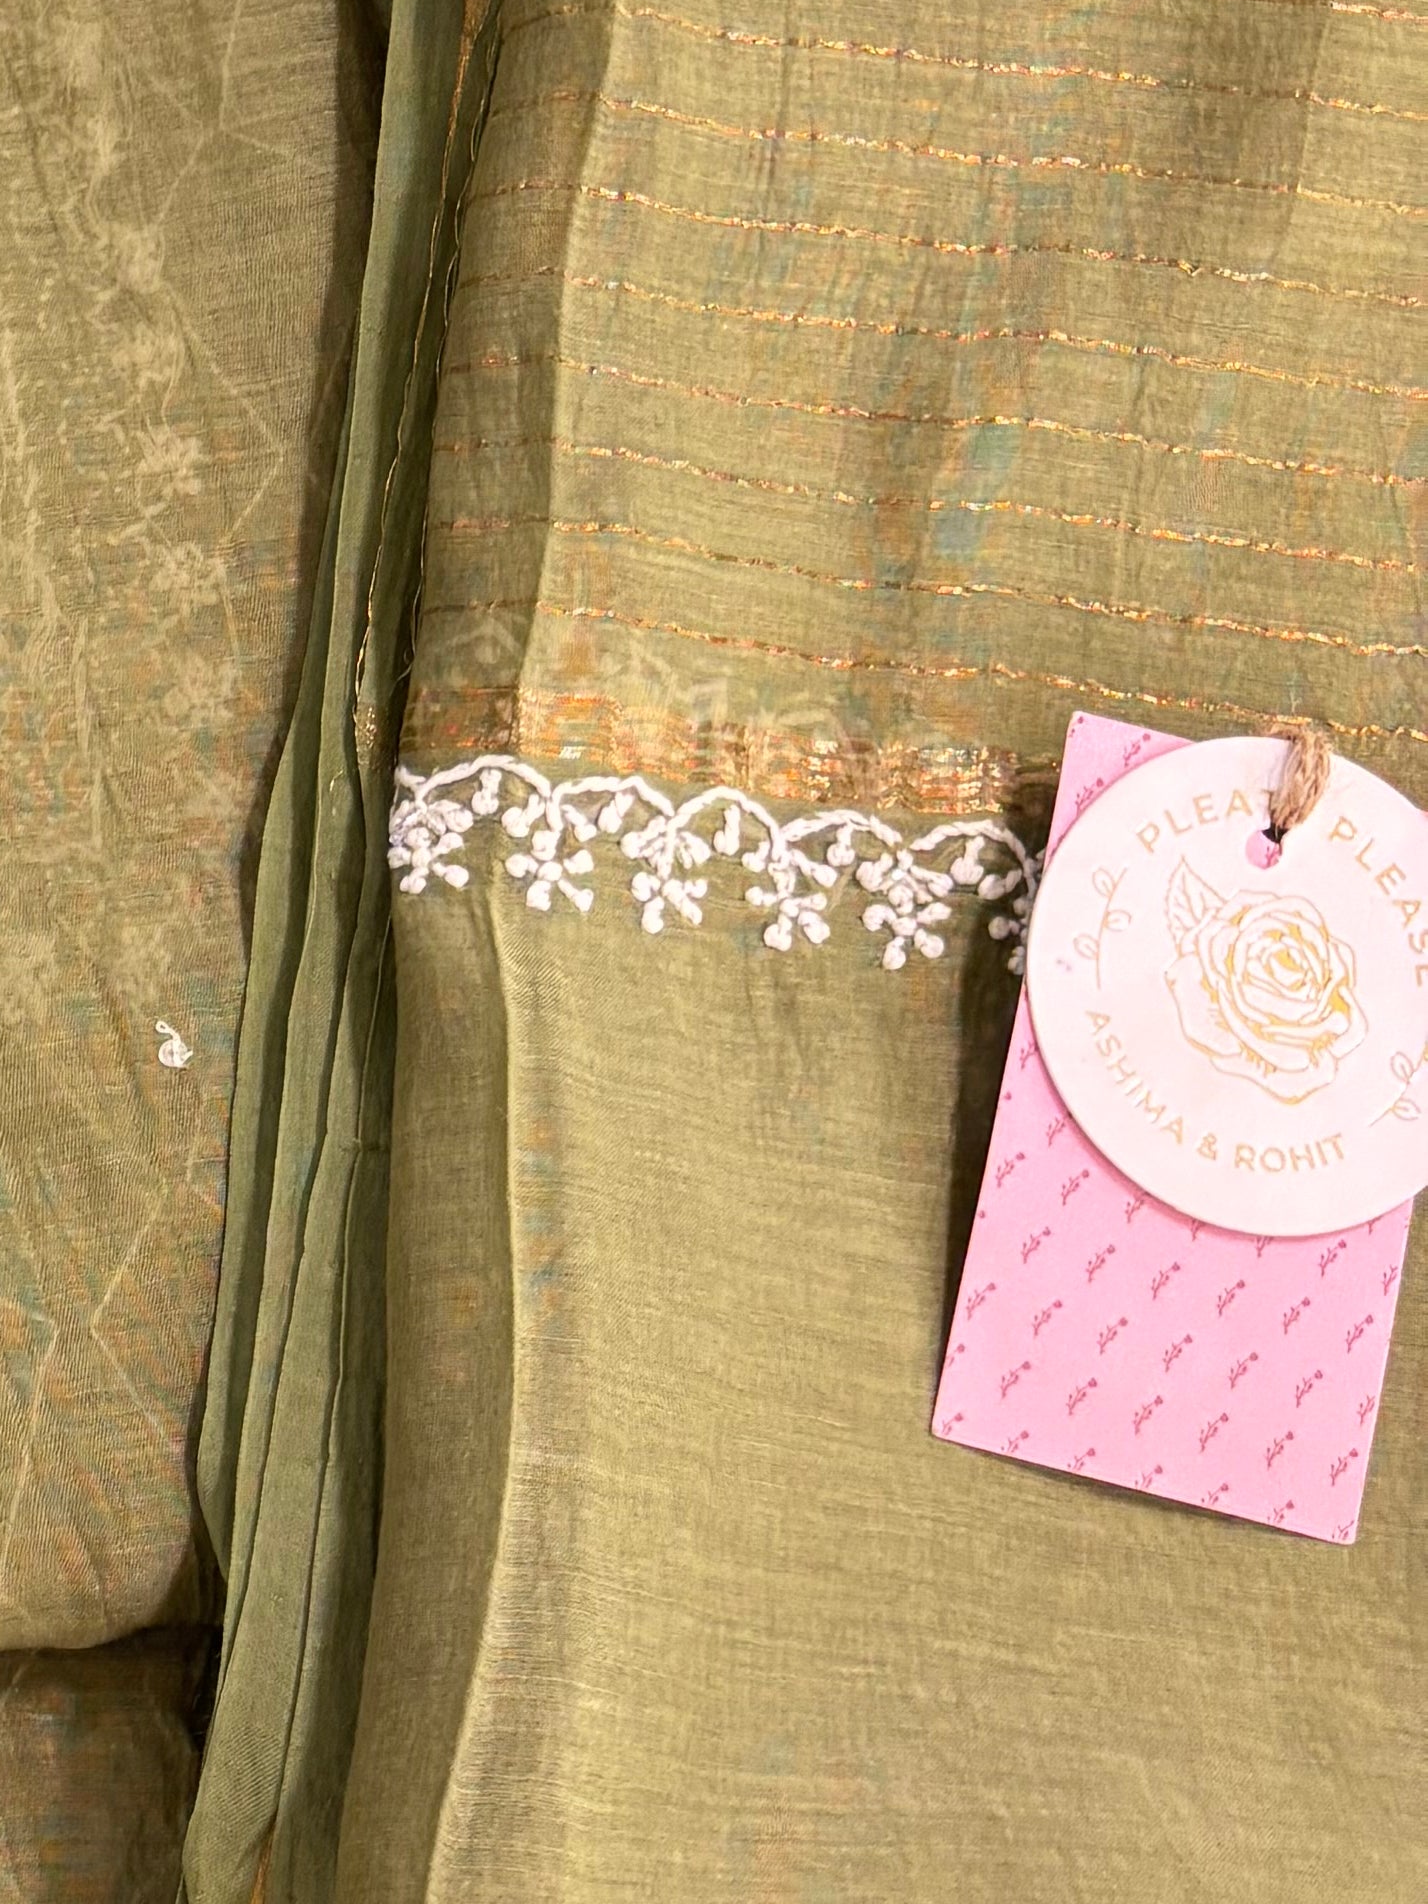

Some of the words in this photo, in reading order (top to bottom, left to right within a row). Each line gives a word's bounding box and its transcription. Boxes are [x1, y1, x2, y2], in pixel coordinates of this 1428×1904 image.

[1085, 1010, 1184, 1144] ASHIMA
[1196, 1132, 1218, 1161] &
[1233, 1132, 1345, 1173] ROHIT
